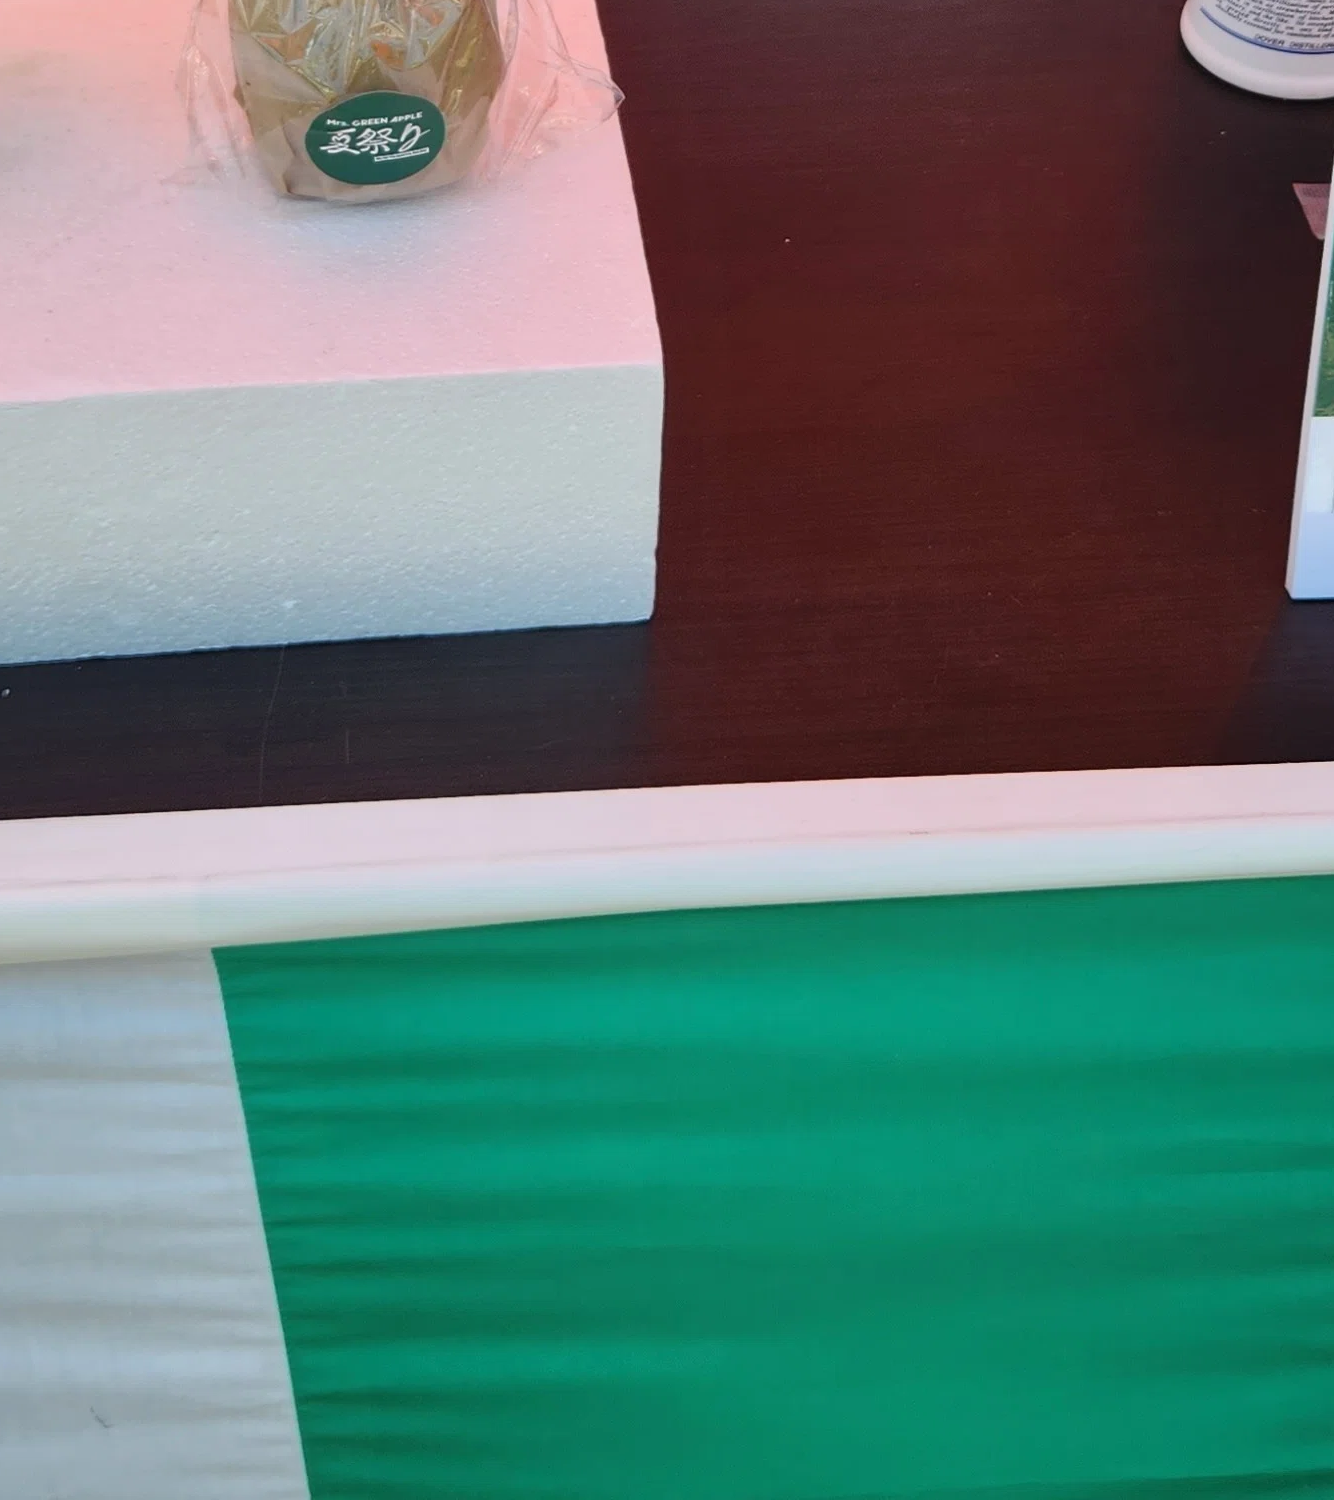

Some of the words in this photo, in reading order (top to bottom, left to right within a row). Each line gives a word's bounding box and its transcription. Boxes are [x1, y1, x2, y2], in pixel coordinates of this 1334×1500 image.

[352, 117, 389, 127] GREEN
[389, 111, 423, 123] APPLE
[319, 123, 431, 155] 夏祭り
